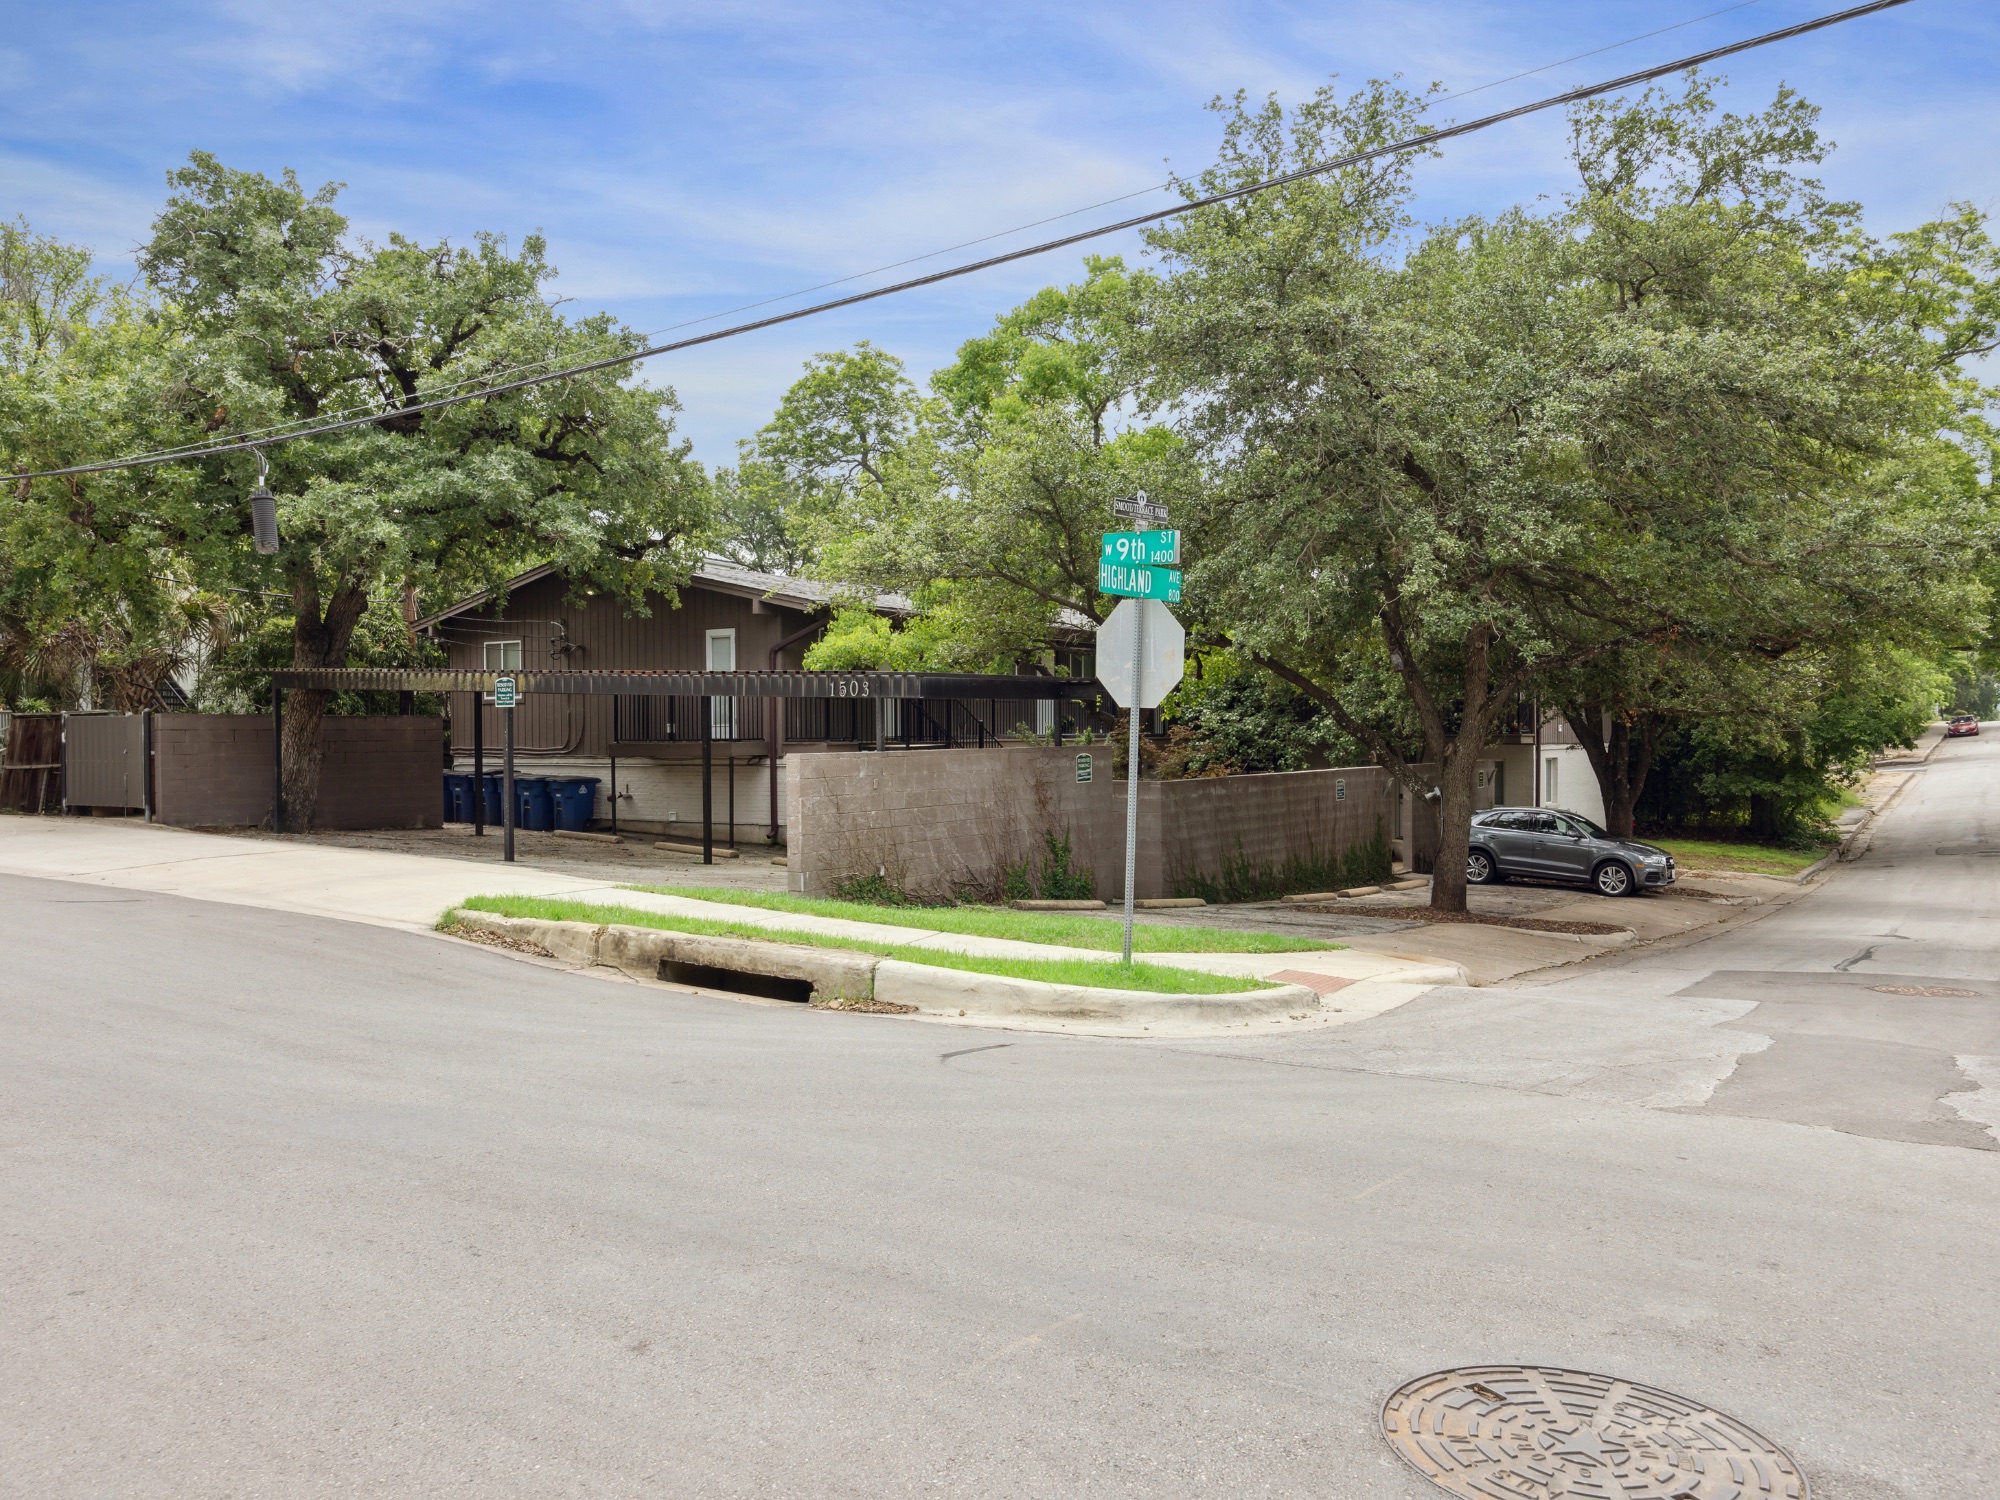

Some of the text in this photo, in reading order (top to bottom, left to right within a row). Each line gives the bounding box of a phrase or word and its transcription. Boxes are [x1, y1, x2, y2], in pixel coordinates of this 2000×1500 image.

[1155, 507, 1167, 518] PARK
[1105, 531, 1173, 561] W 9th ST
[1150, 550, 1174, 563] 1400
[1100, 563, 1181, 594] HIGHLAND AVE
[1168, 589, 1180, 602] 800
[829, 680, 869, 697] 1503
